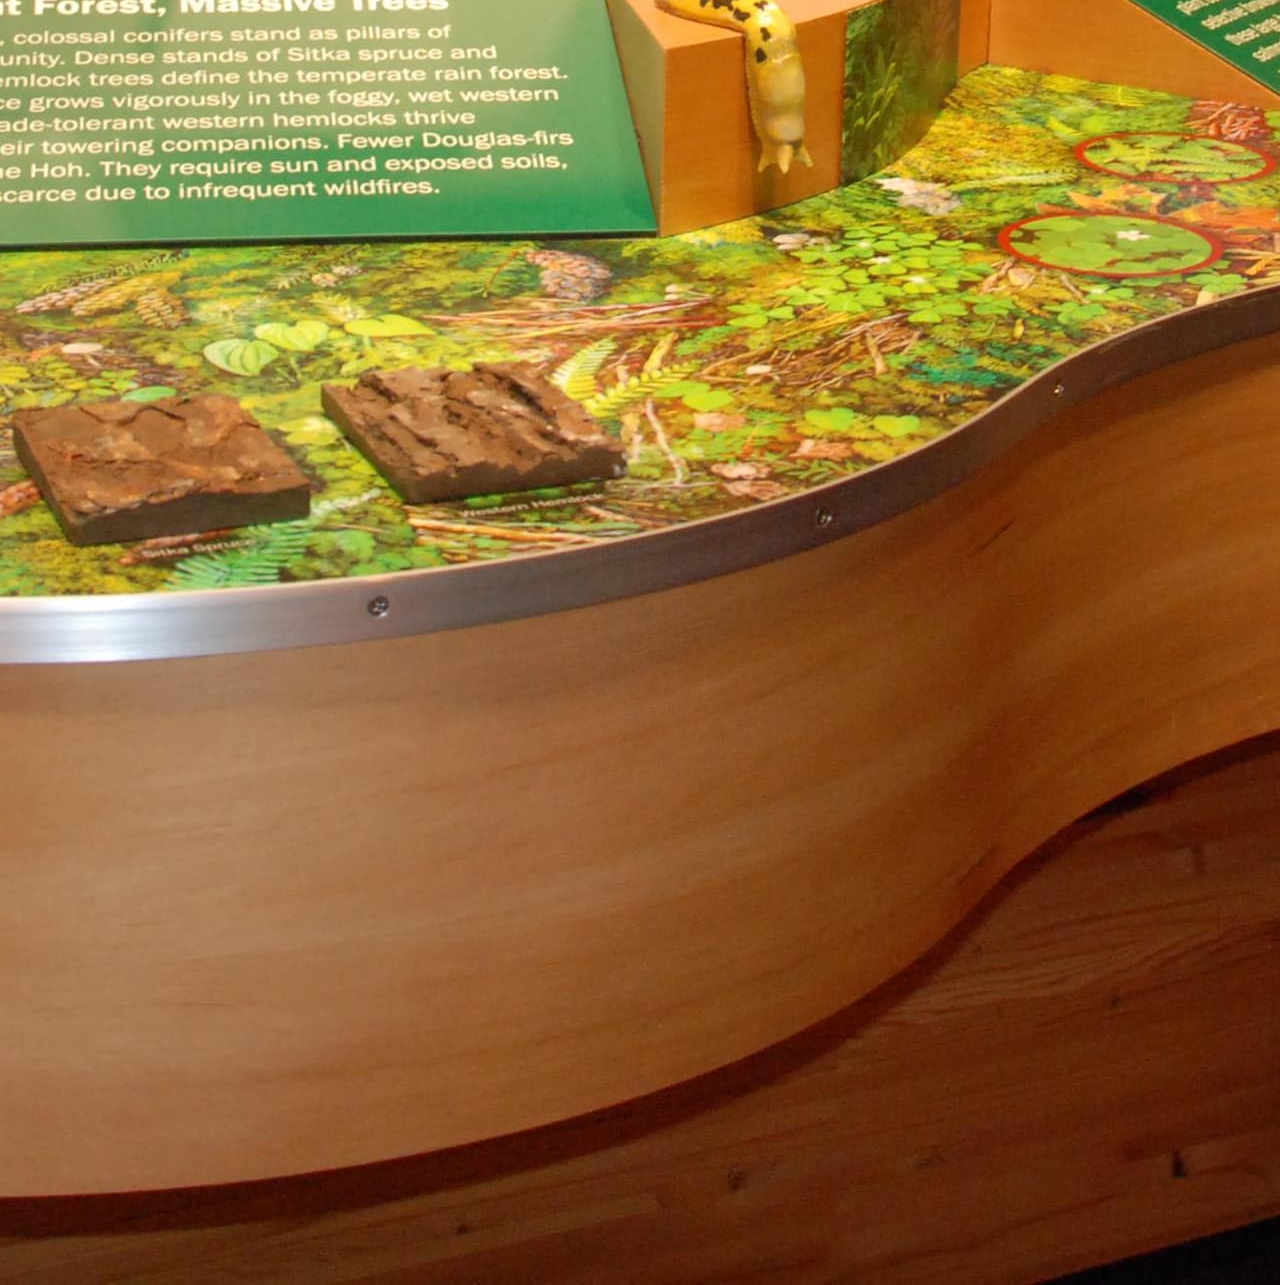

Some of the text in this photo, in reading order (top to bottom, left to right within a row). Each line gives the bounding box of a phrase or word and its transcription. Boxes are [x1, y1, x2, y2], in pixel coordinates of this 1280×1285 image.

[13, 29, 114, 44] colossal
[123, 28, 222, 42] conifers
[230, 26, 300, 40] stand
[309, 29, 337, 39] as
[346, 26, 420, 41] pillars
[427, 24, 450, 38] of
[74, 50, 154, 64] Dense
[162, 48, 247, 63] stands
[256, 47, 280, 61] of
[288, 47, 350, 61] Sitka
[358, 48, 442, 62] spruce
[450, 45, 496, 58] and
[88, 73, 153, 86] trees
[161, 70, 239, 84] define
[247, 69, 288, 83] the
[296, 68, 425, 84] temperate
[434, 66, 481, 80] rain
[489, 65, 567, 79] forest.
[29, 96, 104, 112] grows
[112, 91, 239, 110] vigorously
[248, 91, 270, 105] in
[278, 90, 319, 104] the
[327, 89, 399, 106] foggy,
[408, 89, 452, 102] wet
[459, 88, 558, 101] western
[162, 114, 263, 128] western
[273, 111, 396, 126] hemlocks
[403, 110, 475, 124] thrive
[40, 138, 154, 155] towering
[161, 135, 328, 153] companions.
[337, 133, 414, 148] Fewer
[422, 130, 573, 149] Douglas-firs
[30, 162, 90, 177] Hoh.
[98, 161, 161, 179] They
[169, 158, 262, 177] require
[269, 160, 318, 173] sun
[326, 155, 376, 171] and
[384, 153, 493, 173] exposed
[500, 153, 567, 169] soils,
[84, 185, 136, 200] due
[142, 185, 170, 199] to
[178, 180, 317, 200] infrequent
[323, 178, 439, 195] wildfires.
